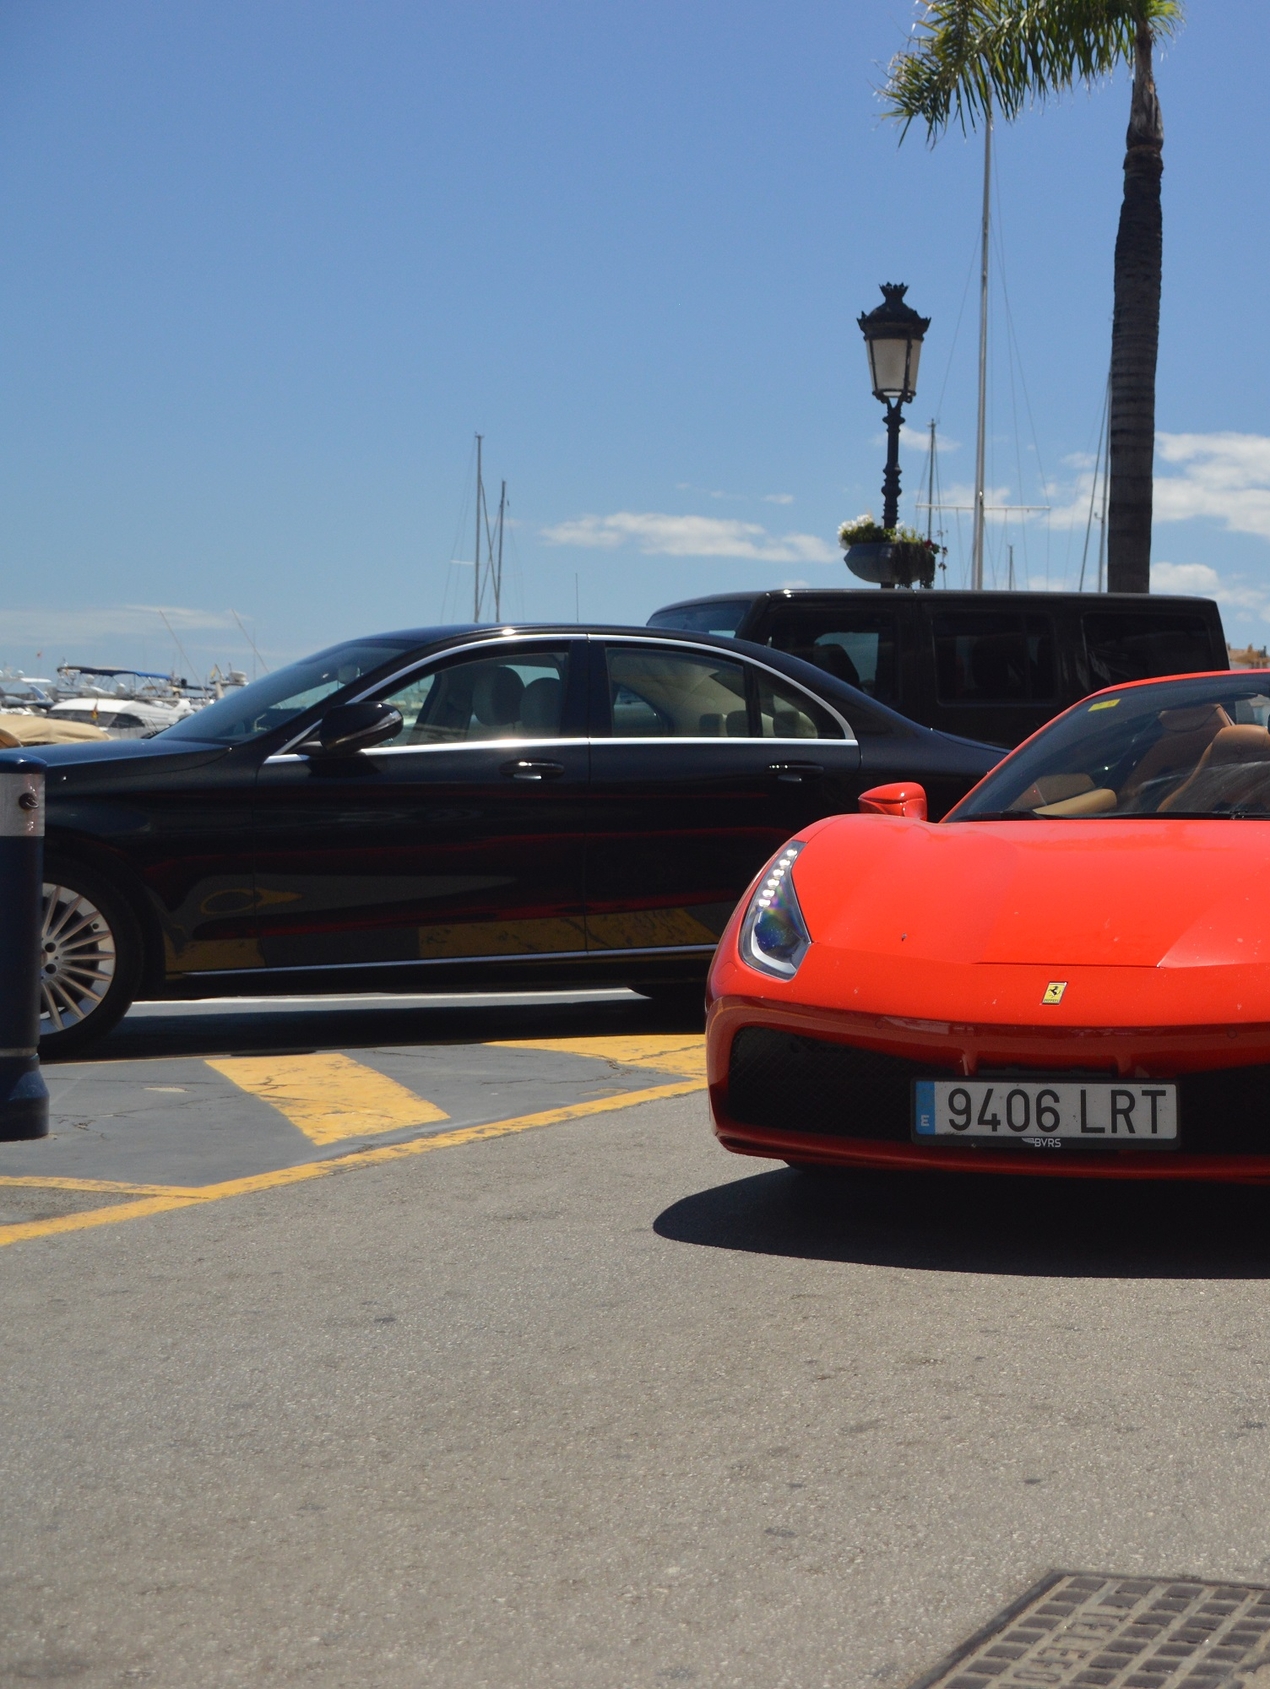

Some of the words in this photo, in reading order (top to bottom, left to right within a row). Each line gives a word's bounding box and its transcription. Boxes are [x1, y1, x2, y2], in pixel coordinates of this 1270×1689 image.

[920, 1115, 930, 1127] E
[948, 1088, 1061, 1132] 9406
[1080, 1089, 1167, 1134] LRT
